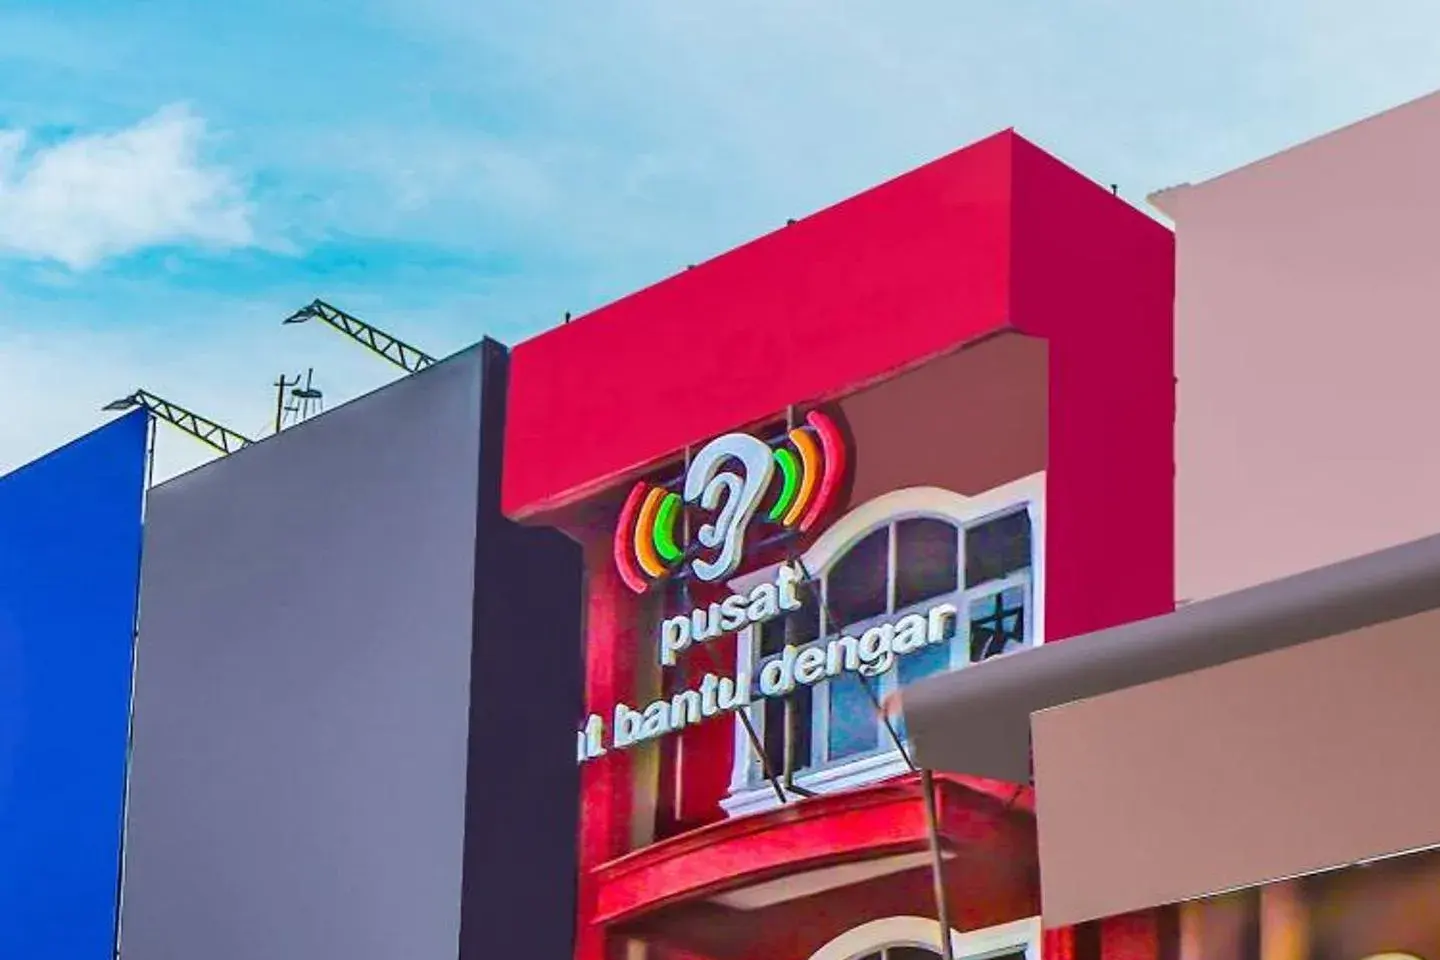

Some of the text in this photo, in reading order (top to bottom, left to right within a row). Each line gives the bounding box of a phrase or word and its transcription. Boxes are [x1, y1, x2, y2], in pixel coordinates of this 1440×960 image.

[613, 671, 750, 748] bantu
[759, 603, 957, 697] dengar
[661, 558, 803, 667] pusat
